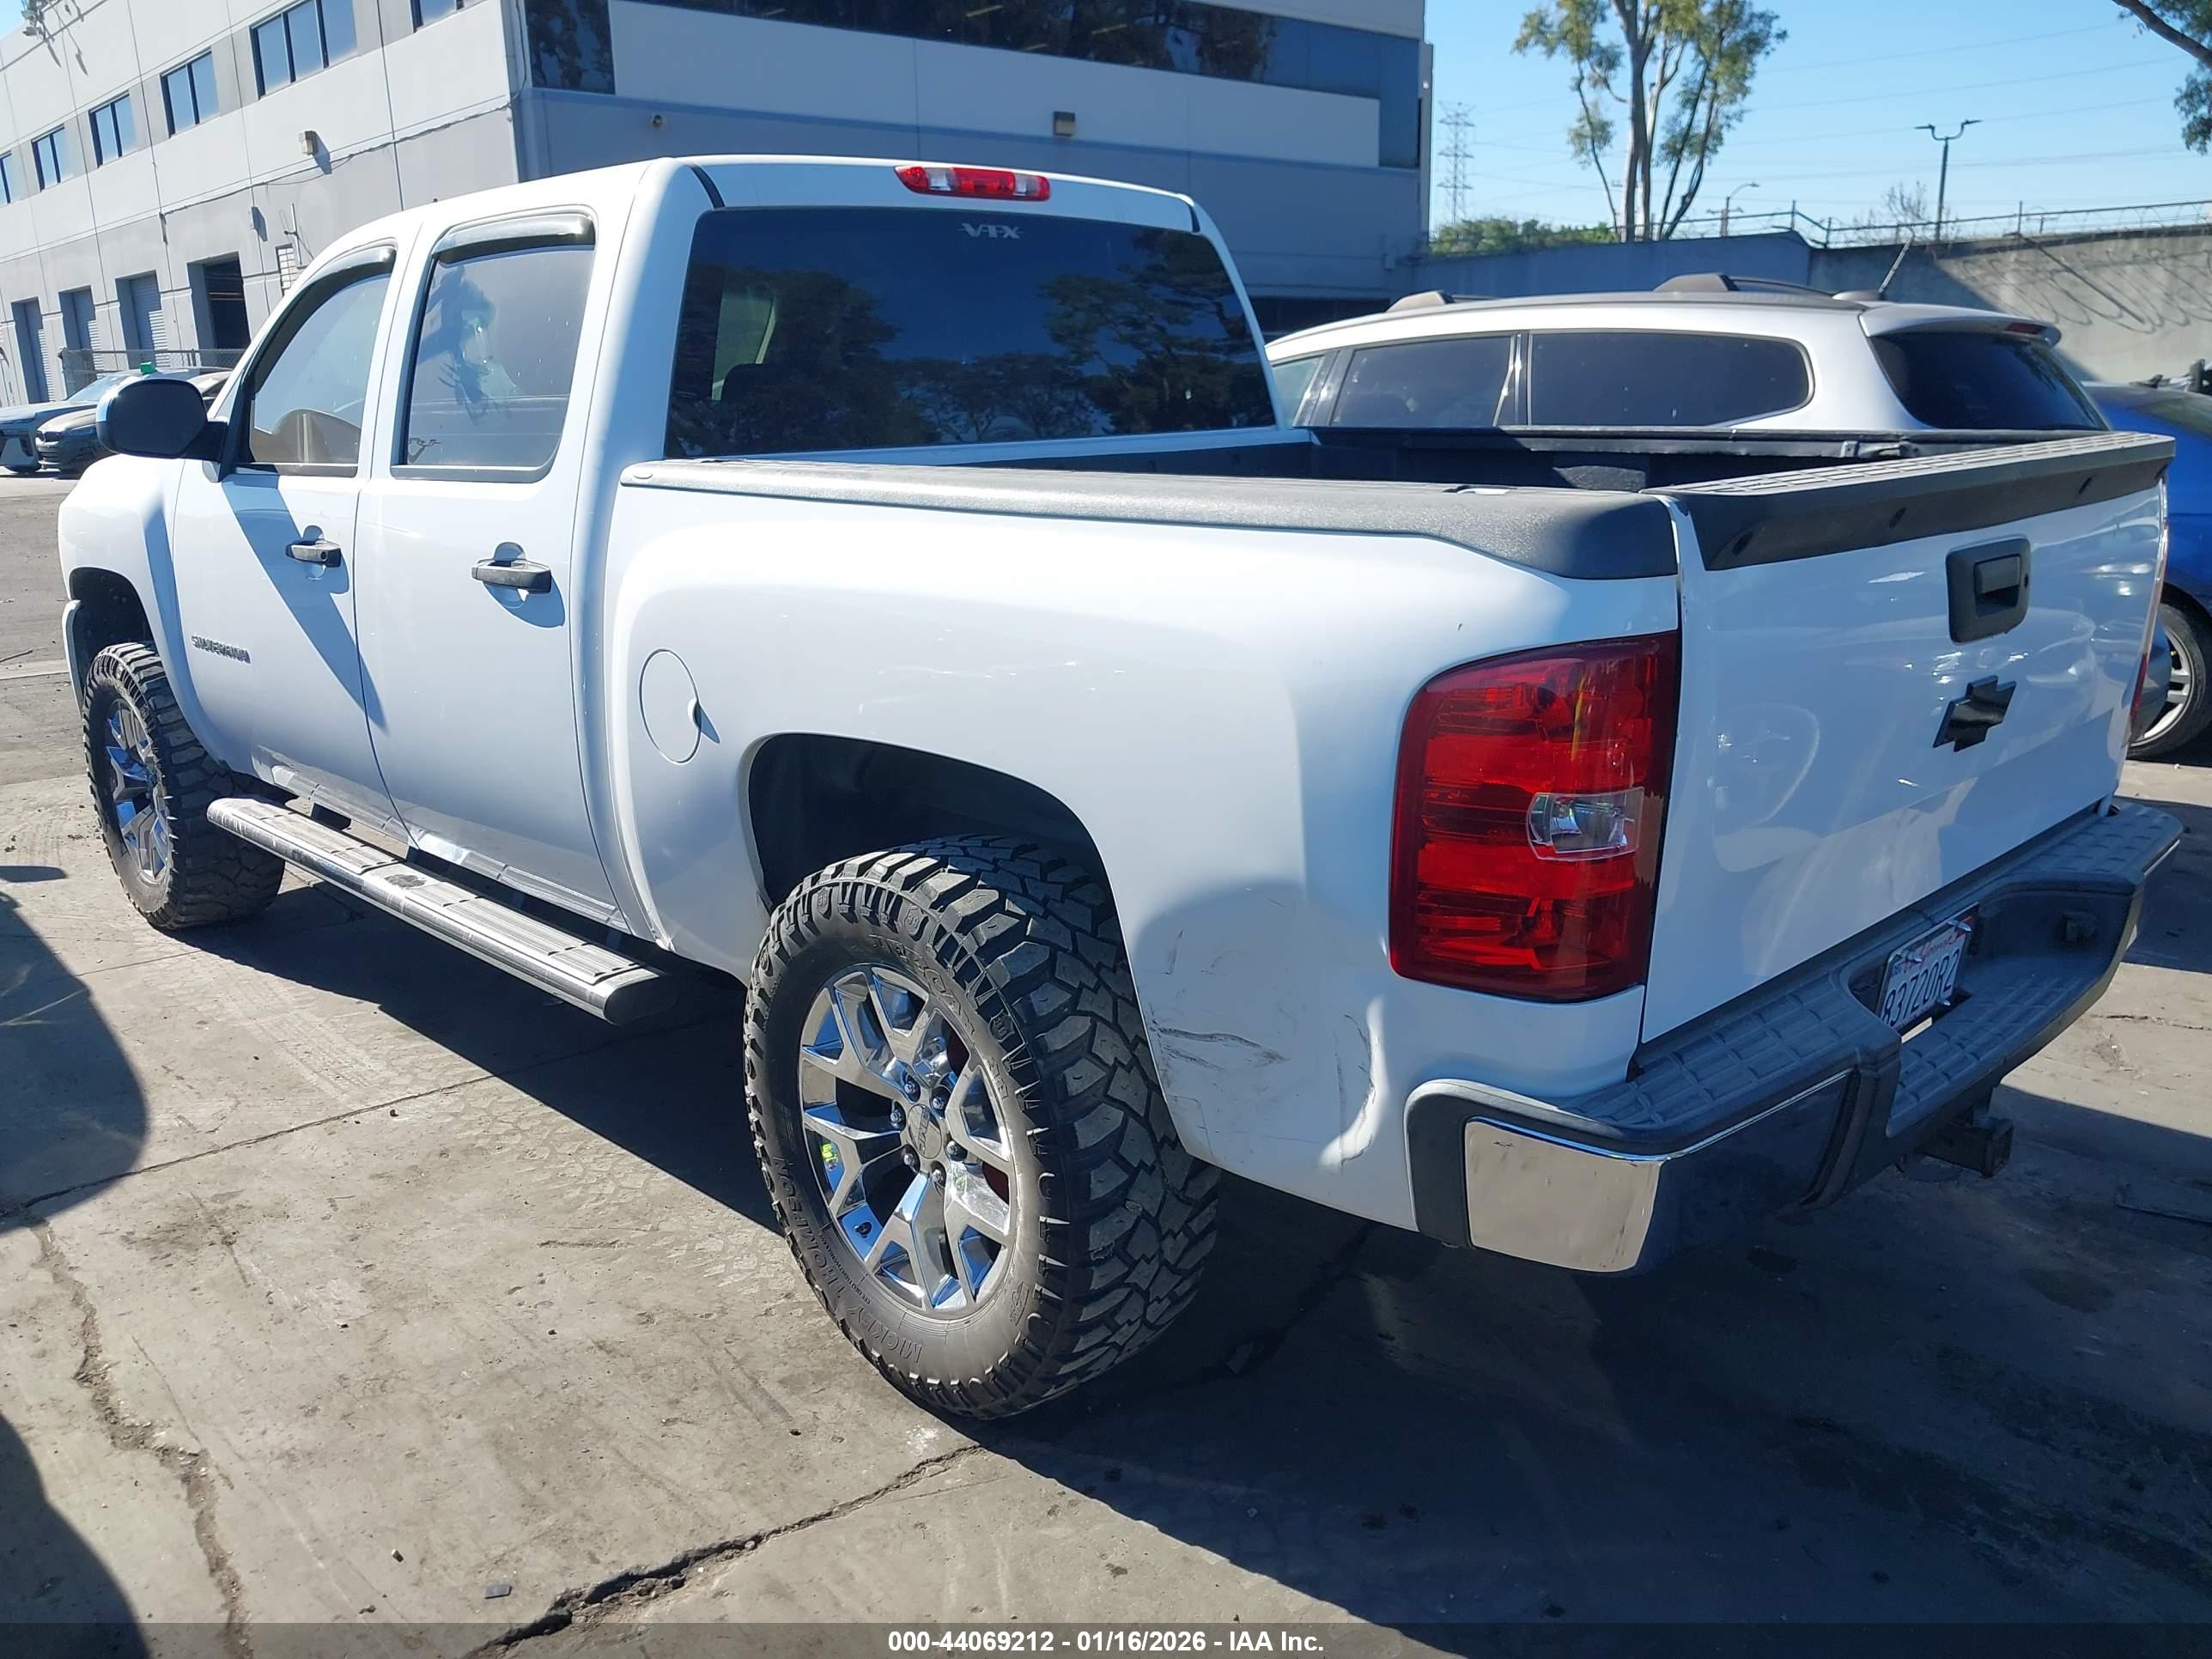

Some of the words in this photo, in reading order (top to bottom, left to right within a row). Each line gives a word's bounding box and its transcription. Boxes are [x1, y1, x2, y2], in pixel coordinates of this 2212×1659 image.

[1881, 948, 1960, 1028] 83720R2
[918, 1105, 930, 1155] GMC
[770, 1155, 847, 1299] THOMPSON
[848, 1305, 925, 1364] MICKEY
